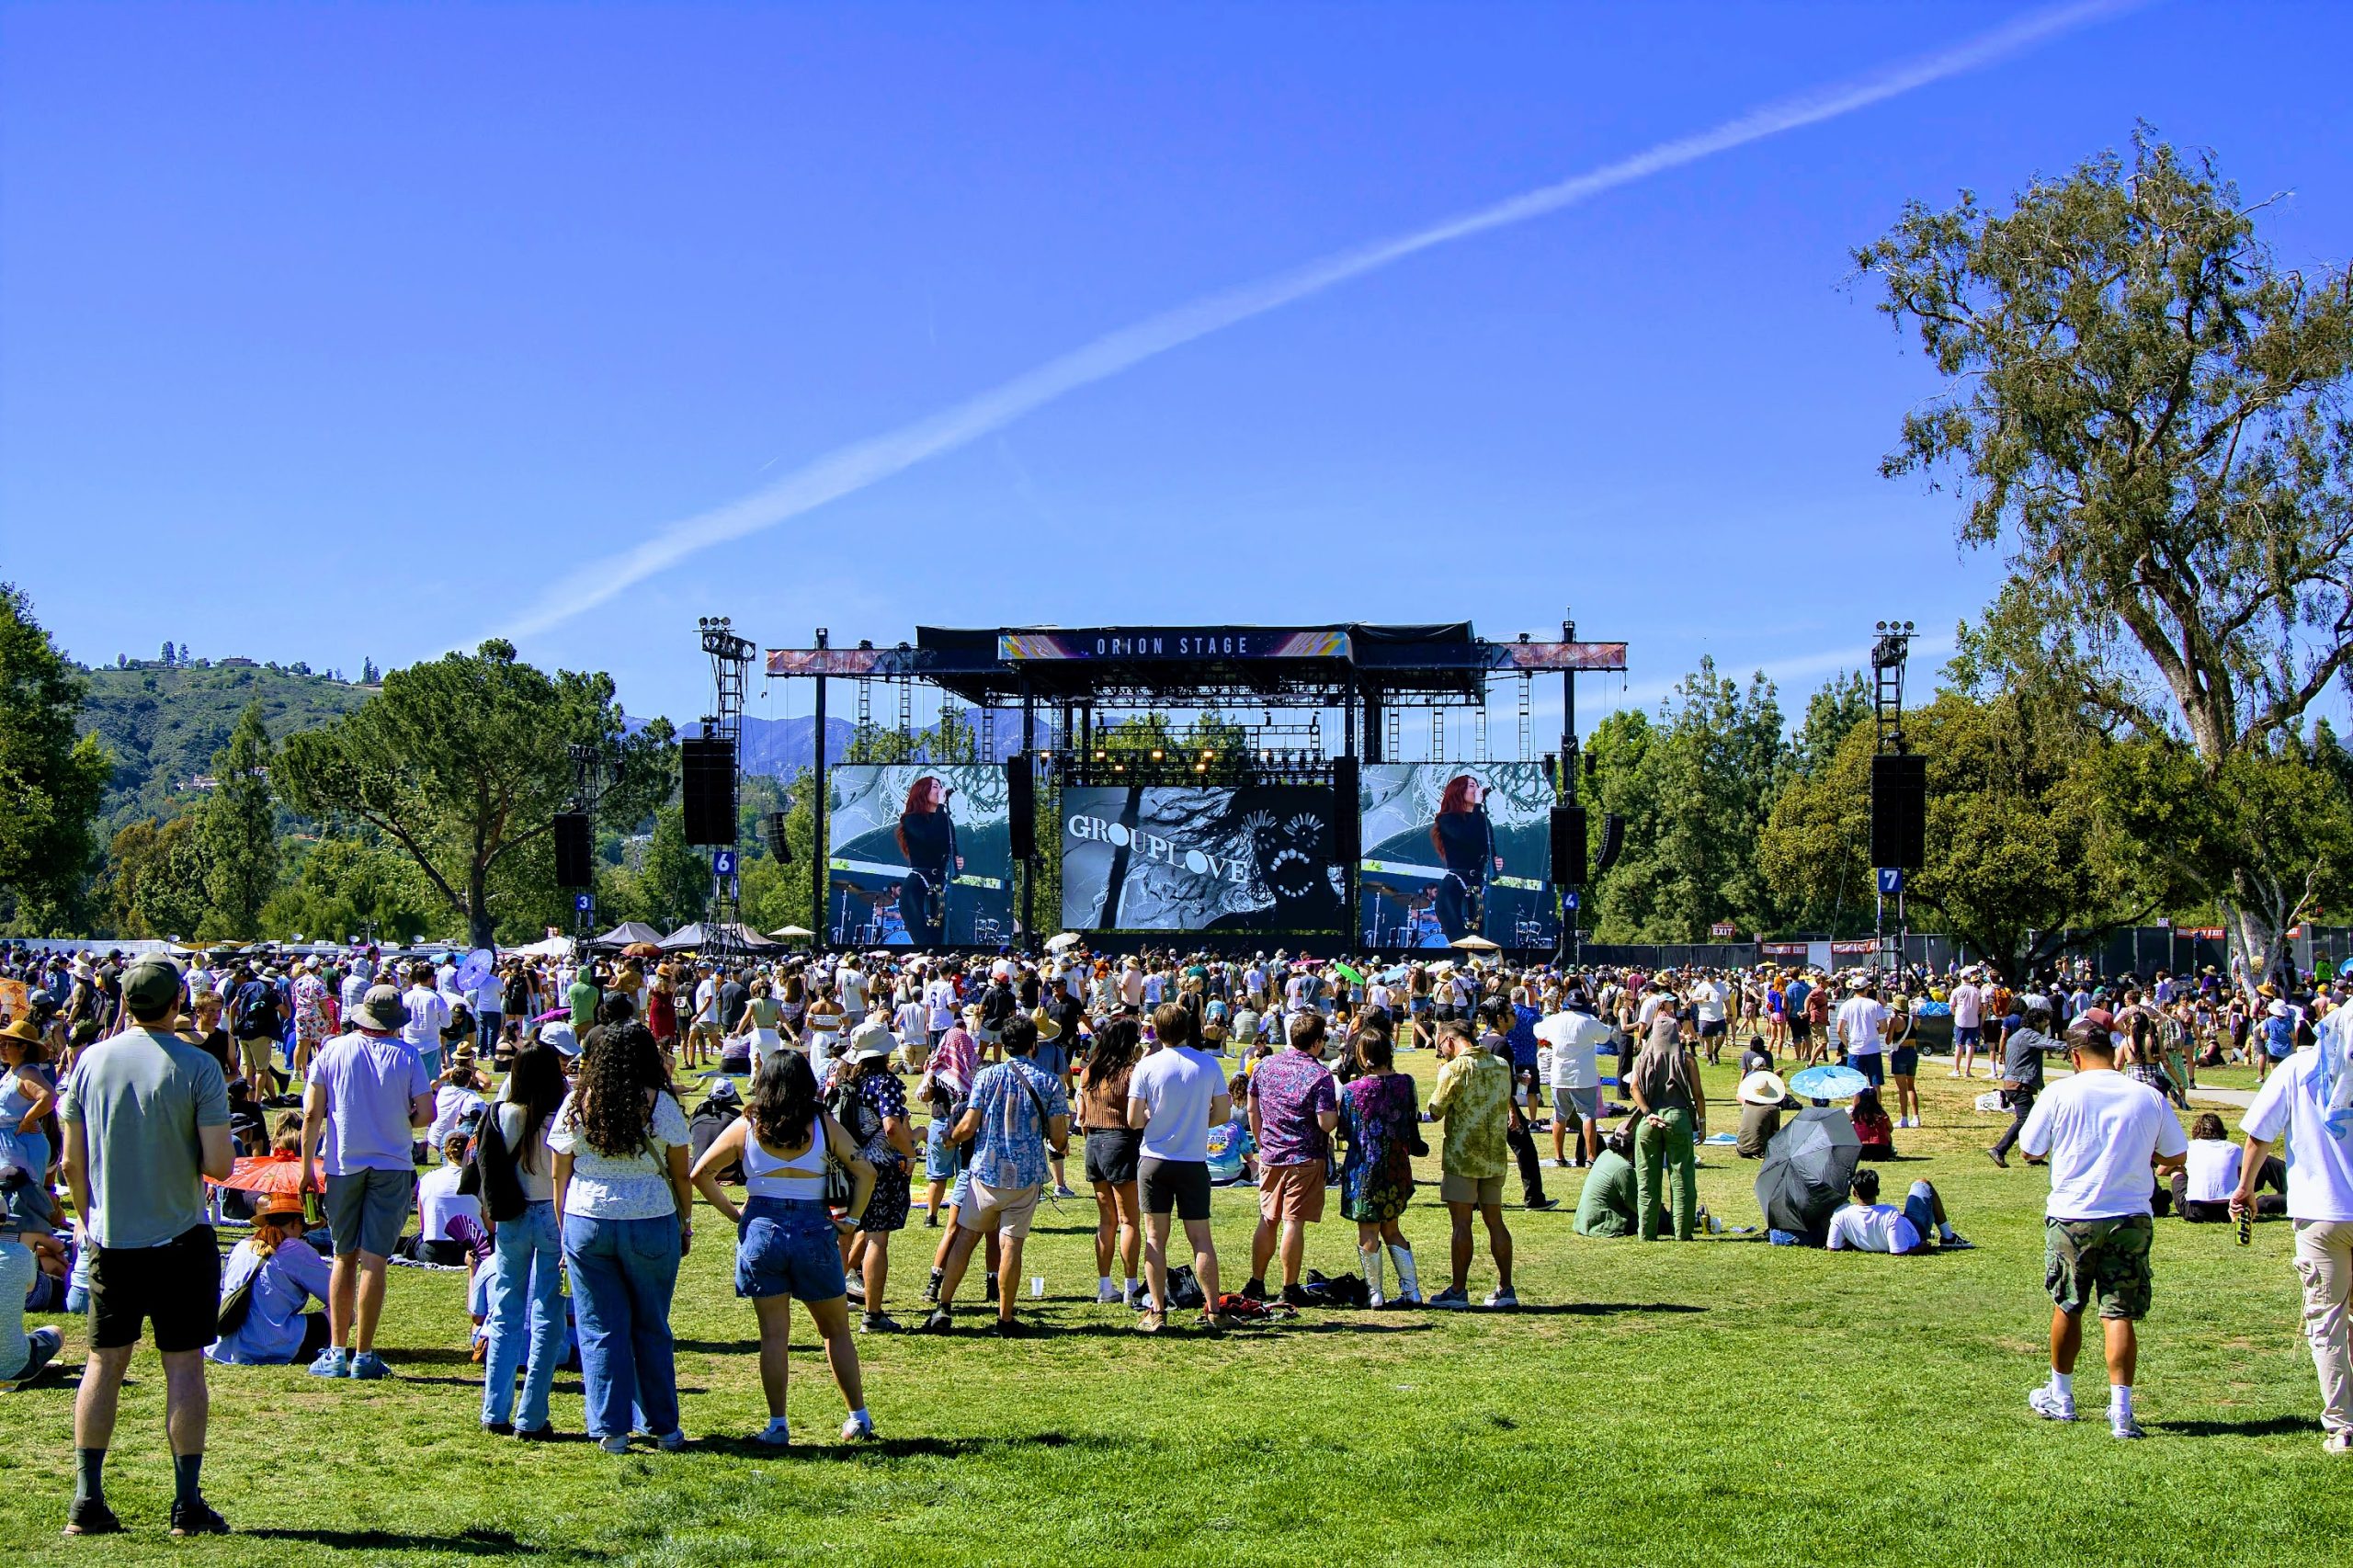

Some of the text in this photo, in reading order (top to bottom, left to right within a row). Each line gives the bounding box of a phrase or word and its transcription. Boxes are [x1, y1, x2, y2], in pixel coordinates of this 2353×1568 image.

[1097, 637, 1246, 654] ORION STAGE
[1068, 814, 1249, 884] GROUPLOVE
[718, 854, 730, 871] 6
[1884, 870, 1898, 890] 7
[579, 895, 588, 909] 3
[1566, 894, 1574, 907] 4
[1712, 927, 1733, 936] EXIT
[2208, 929, 2223, 937] EXIT
[1793, 946, 1806, 954] EXIT
